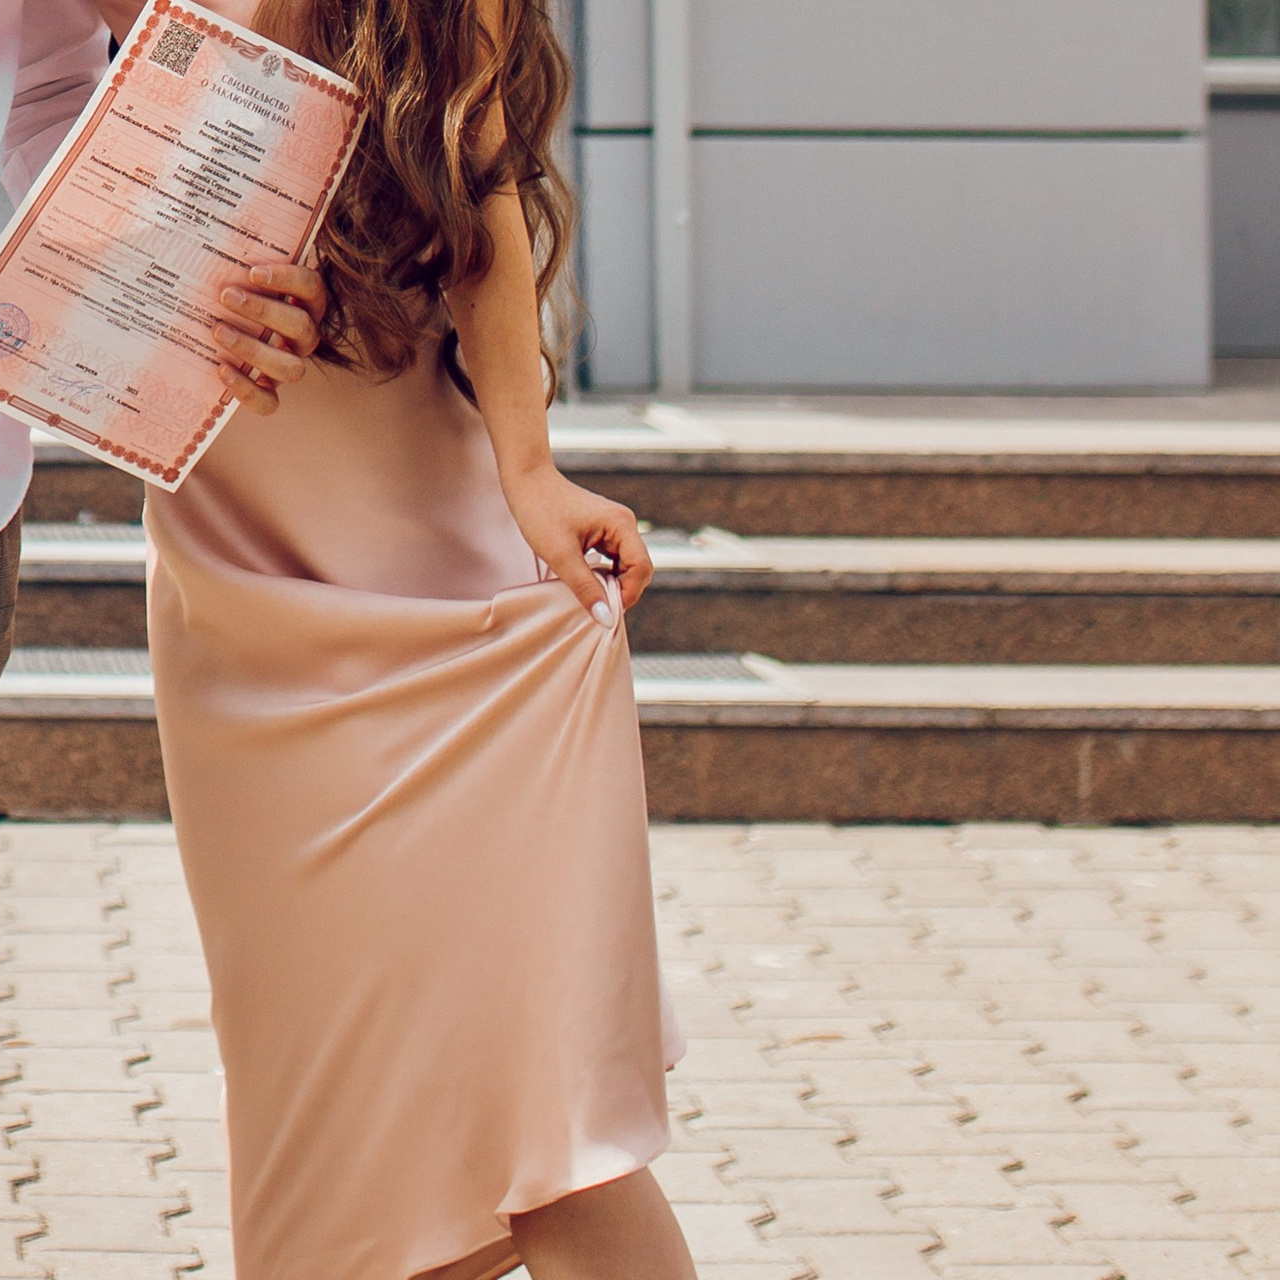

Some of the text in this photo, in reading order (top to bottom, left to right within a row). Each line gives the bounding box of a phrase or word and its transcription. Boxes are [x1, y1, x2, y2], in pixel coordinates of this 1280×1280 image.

[208, 82, 271, 119] ЗАКЛЮЧЕНИИ
[270, 112, 298, 132] БРАКА
[220, 73, 290, 113] СВИДЕТЕЛЬСТВО
[109, 107, 143, 128] Российская
